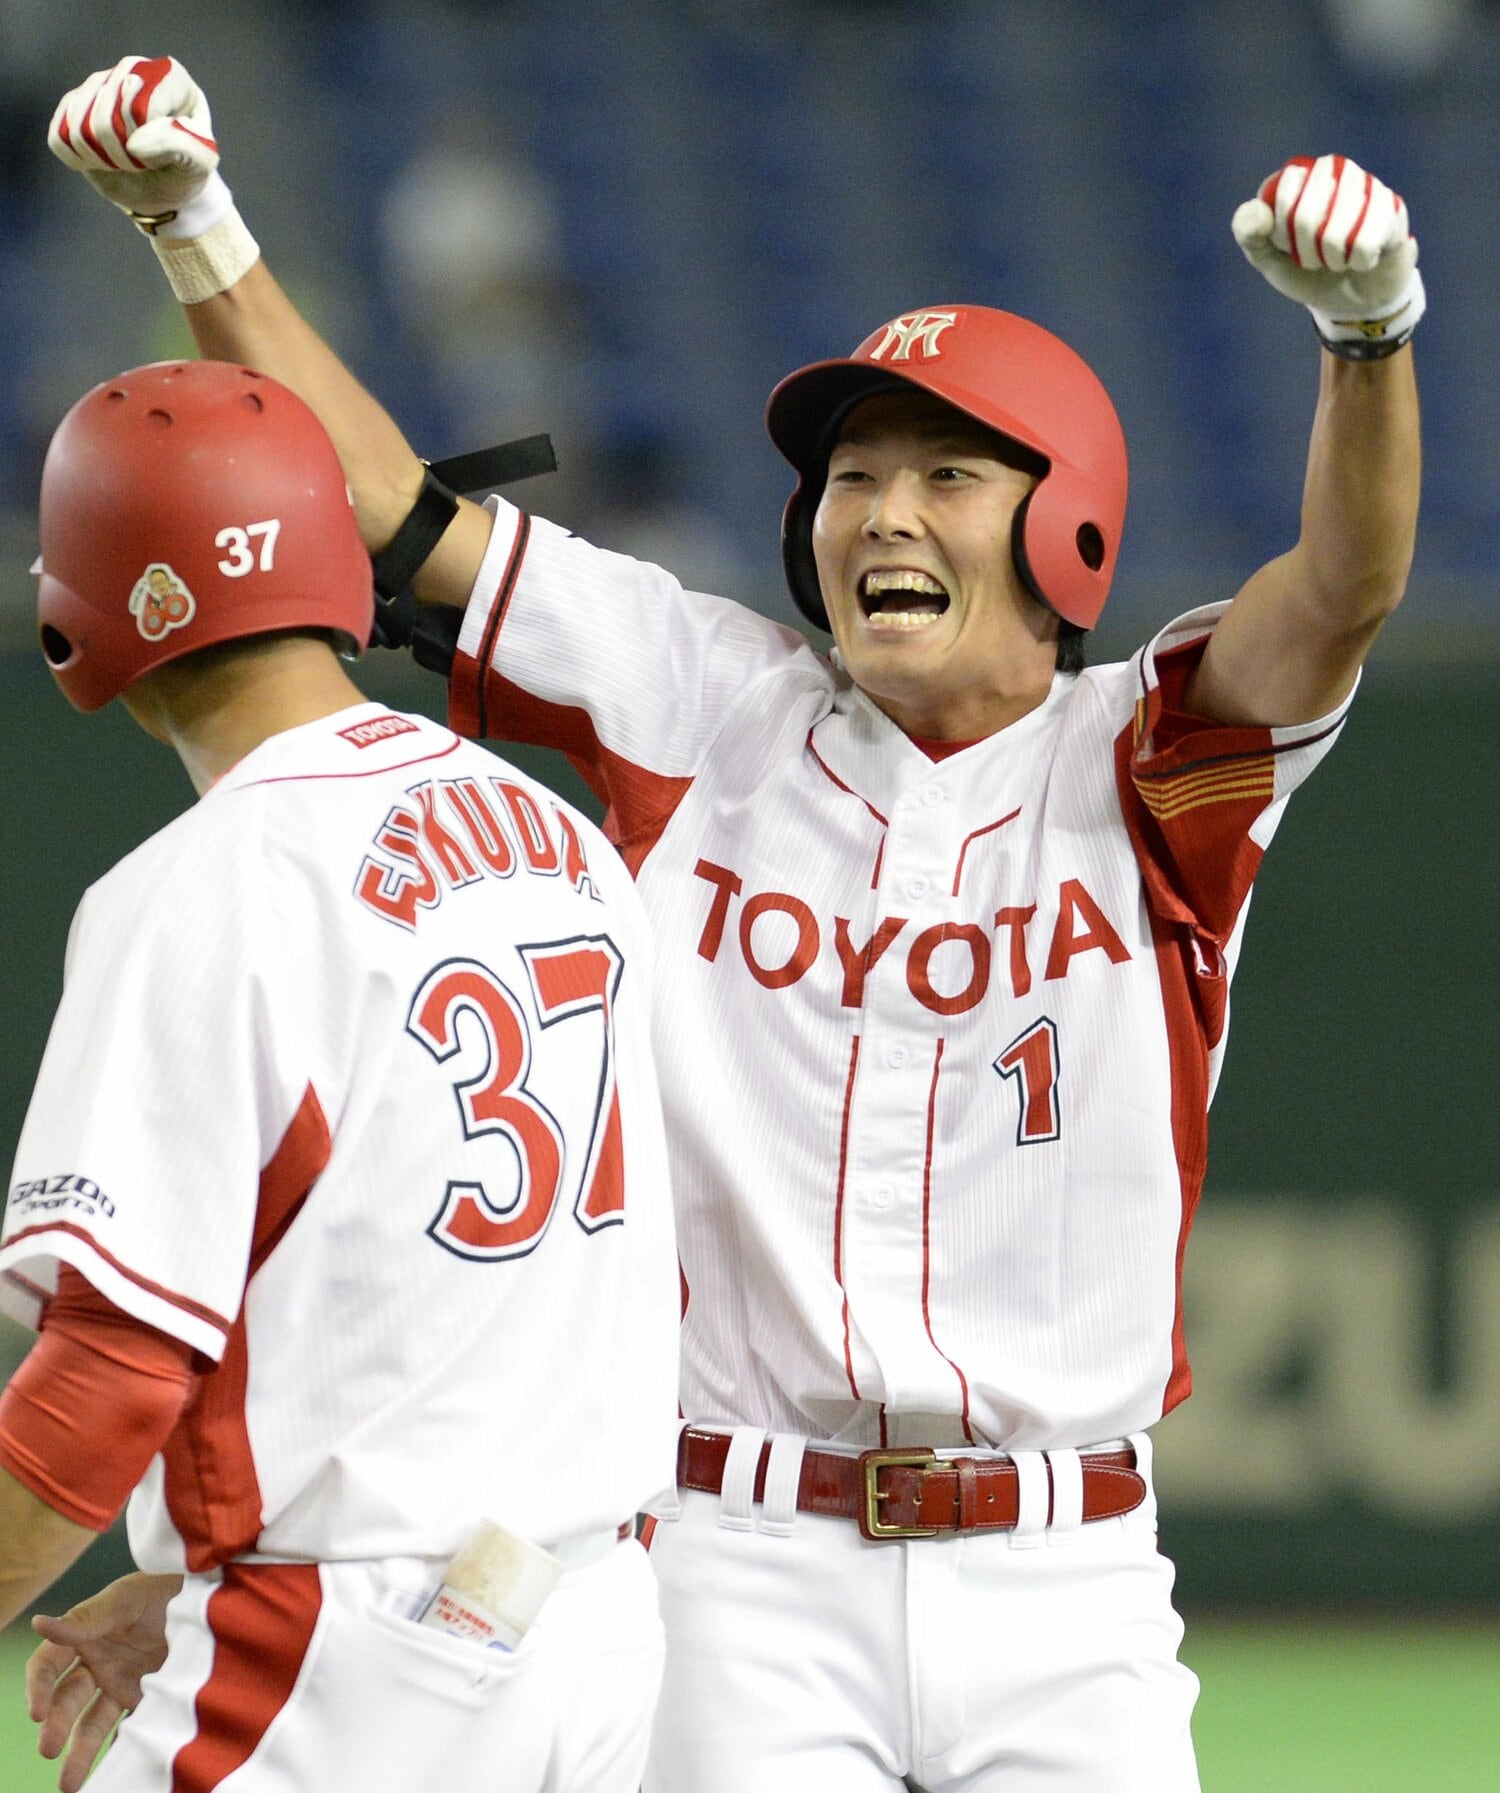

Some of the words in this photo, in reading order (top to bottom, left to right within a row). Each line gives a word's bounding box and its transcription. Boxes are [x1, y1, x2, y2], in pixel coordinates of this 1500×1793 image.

[214, 519, 282, 578] 37
[693, 858, 1133, 1016] TOYOTA
[405, 933, 625, 1263] 37
[992, 1015, 1061, 1147] 1
